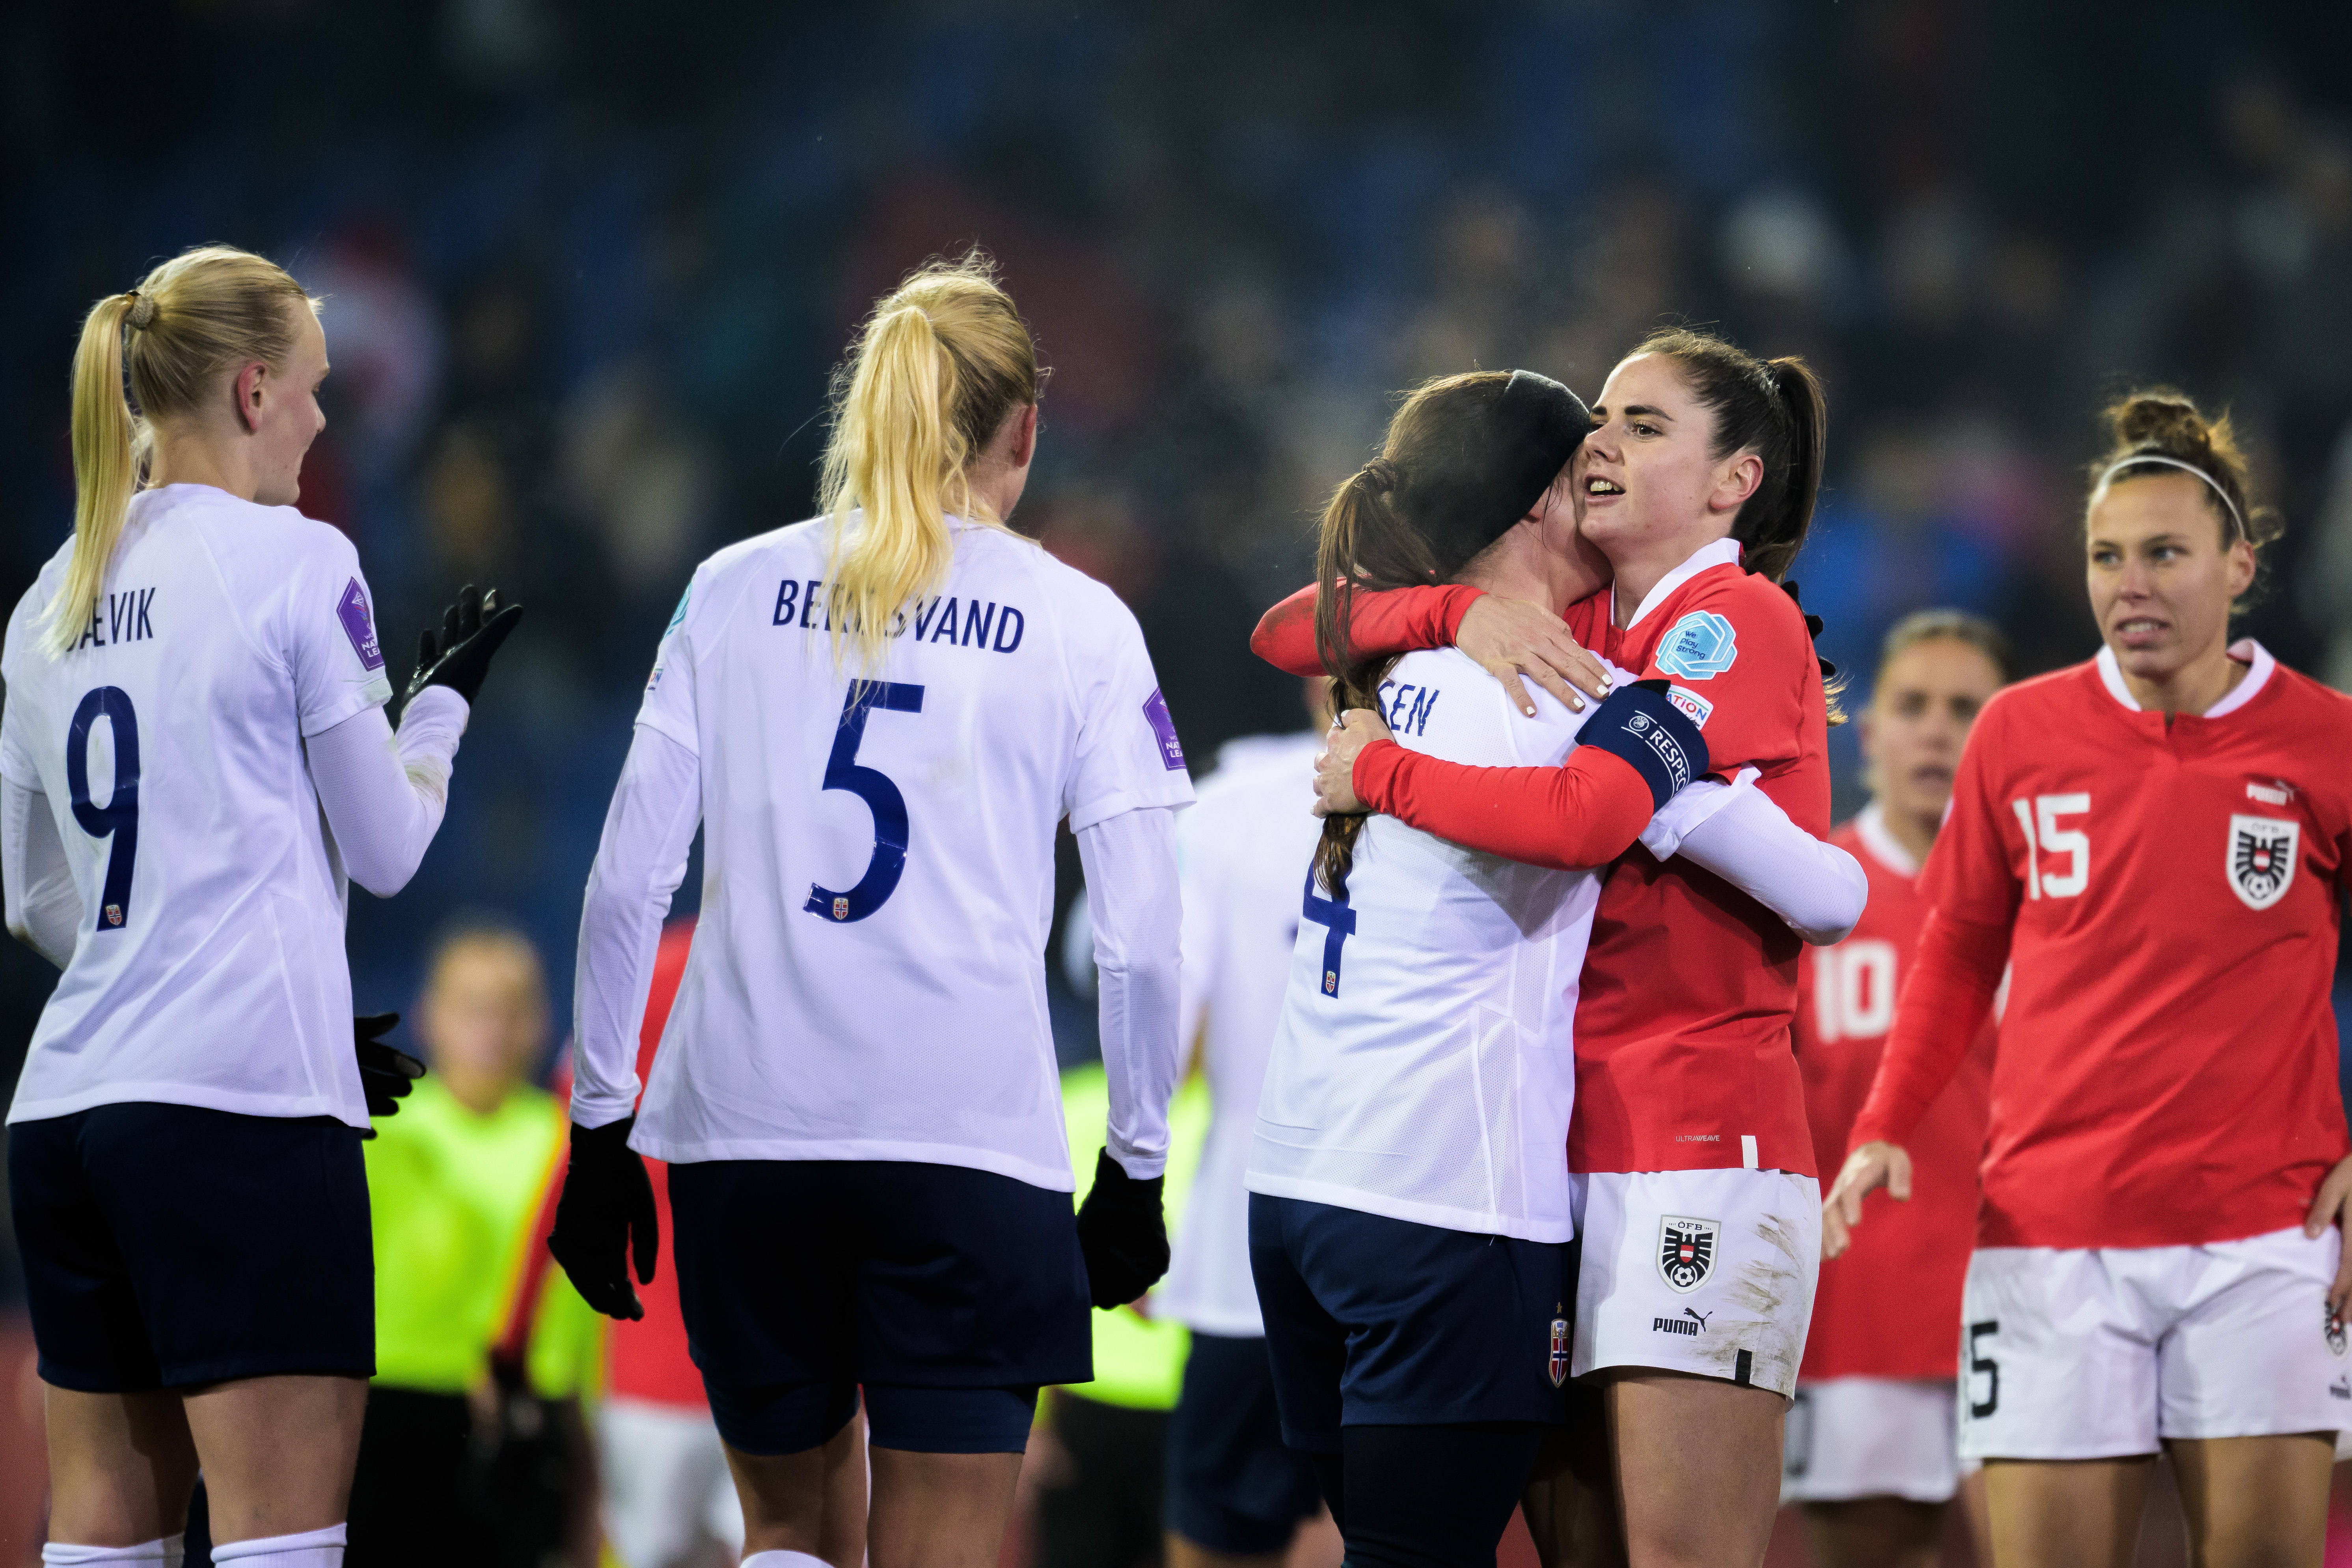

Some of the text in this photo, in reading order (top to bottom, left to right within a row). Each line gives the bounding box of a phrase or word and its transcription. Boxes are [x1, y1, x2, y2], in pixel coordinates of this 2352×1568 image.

[66, 587, 156, 652] ÆVIK
[1676, 645, 1705, 660] Strong
[66, 686, 140, 932] 9
[803, 679, 925, 923] 5
[2013, 793, 2089, 900] 15
[1303, 854, 1357, 999] 4
[1813, 942, 1895, 1042] 10
[1678, 1221, 1702, 1231] ÖFB
[1653, 1318, 1698, 1336] PUMA
